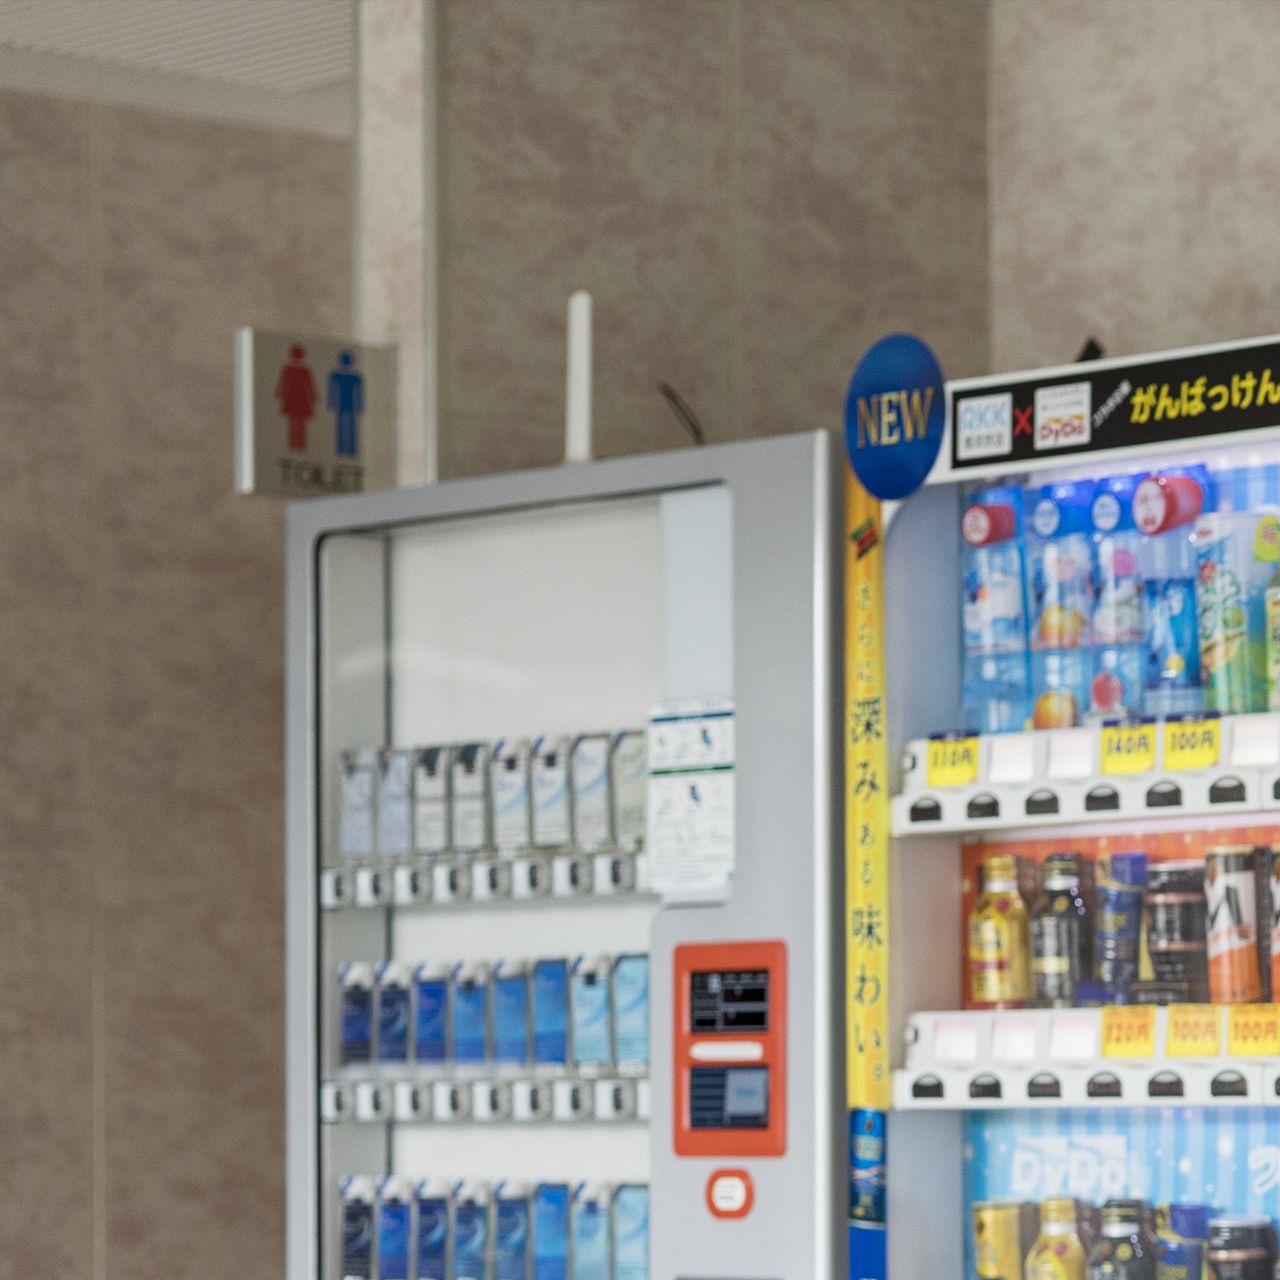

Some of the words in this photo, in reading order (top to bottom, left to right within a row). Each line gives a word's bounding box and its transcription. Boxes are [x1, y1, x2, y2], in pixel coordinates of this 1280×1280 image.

[856, 387, 934, 449] NEW
[1105, 735, 1151, 756] 140円
[1169, 727, 1217, 752] 100円
[1234, 1018, 1279, 1041] 100円
